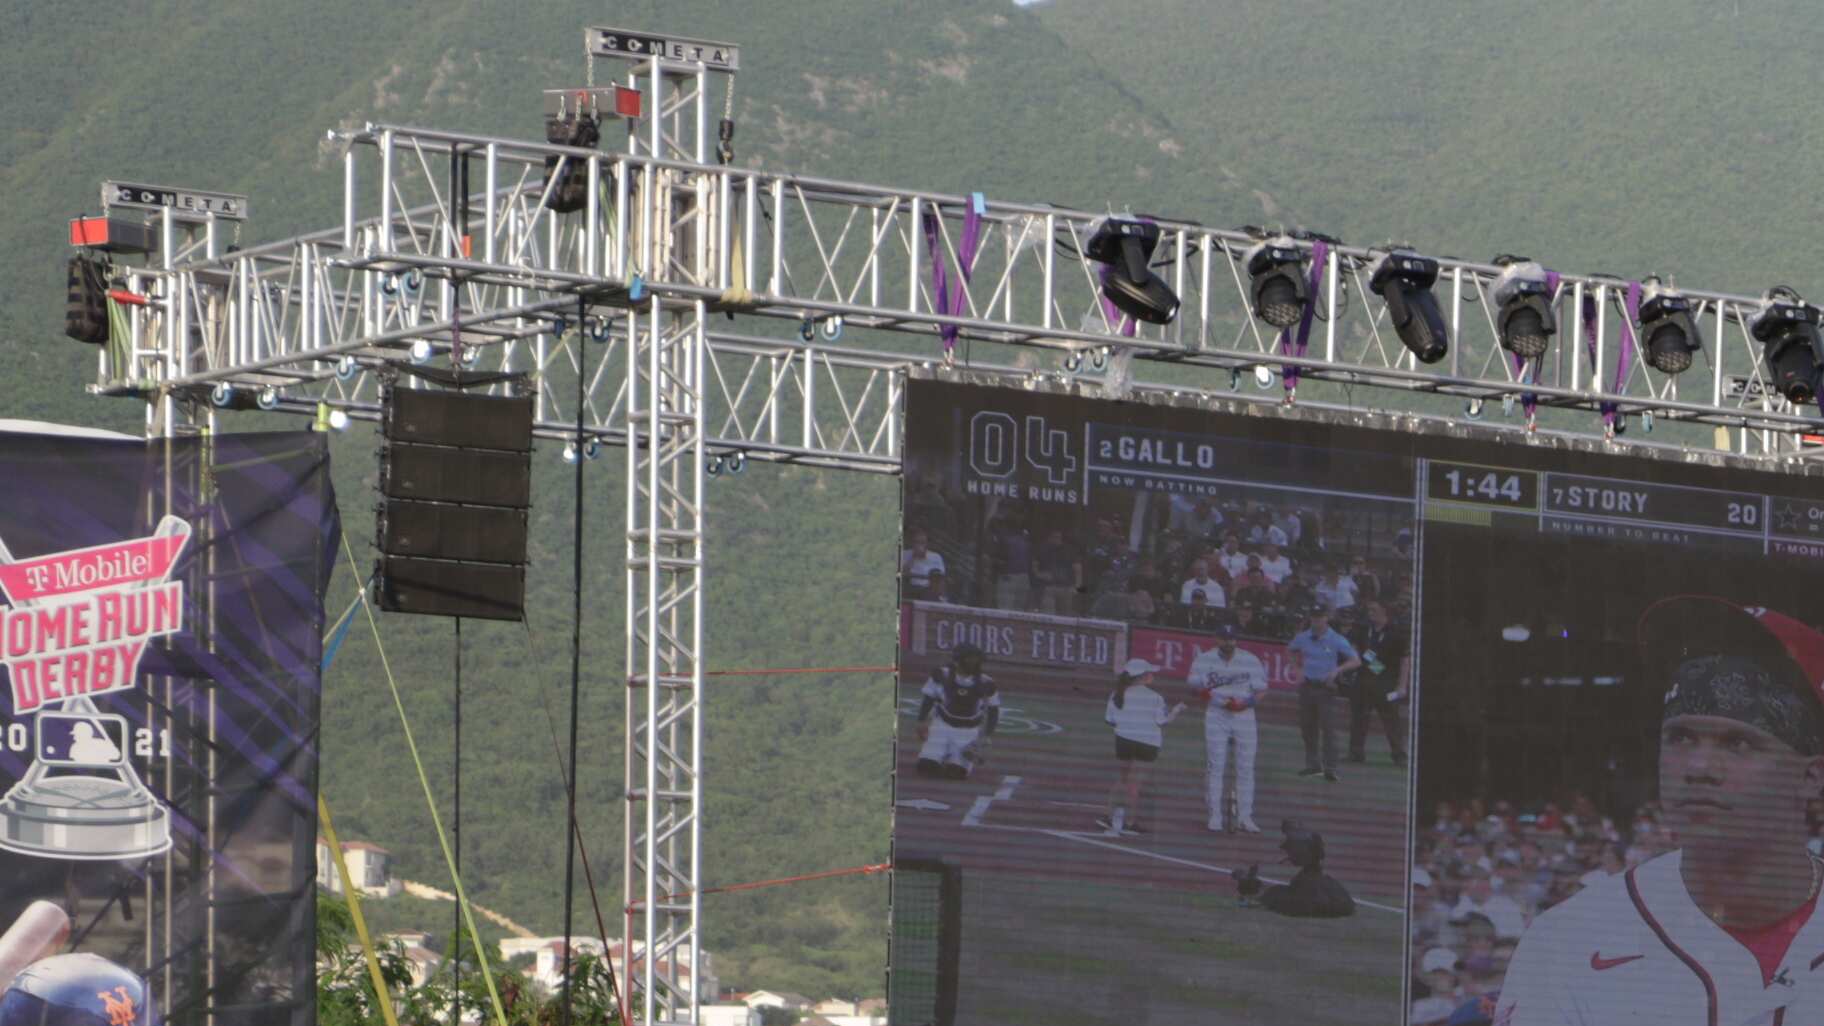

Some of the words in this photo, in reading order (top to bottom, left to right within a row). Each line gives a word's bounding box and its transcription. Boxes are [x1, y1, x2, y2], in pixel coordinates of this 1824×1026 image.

[606, 35, 724, 62] COMETA
[120, 188, 232, 212] COMETA
[970, 410, 1076, 484] 04
[1100, 440, 1113, 458] 2
[1118, 436, 1214, 469] GALLO
[967, 480, 1019, 499] HOME
[1028, 486, 1077, 504] RUNS
[1100, 475, 1135, 486] NOW
[1145, 479, 1218, 496] BATTING
[1445, 469, 1521, 502] 1:44
[1552, 489, 1563, 505] 7
[1567, 487, 1648, 513] STORY
[1727, 502, 1757, 526] 20
[1552, 520, 1616, 537] NUMBER
[1625, 528, 1643, 541] TO
[1651, 530, 1690, 544] BEAT
[26, 564, 49, 592] T
[53, 550, 147, 590] Mobile
[0, 603, 91, 662] OME
[99, 586, 180, 642] RUN
[936, 619, 1015, 656] COORS
[1031, 628, 1109, 666] FIELD
[13, 641, 144, 711] DERBY
[0, 722, 27, 752] 0
[135, 728, 171, 757] 21
